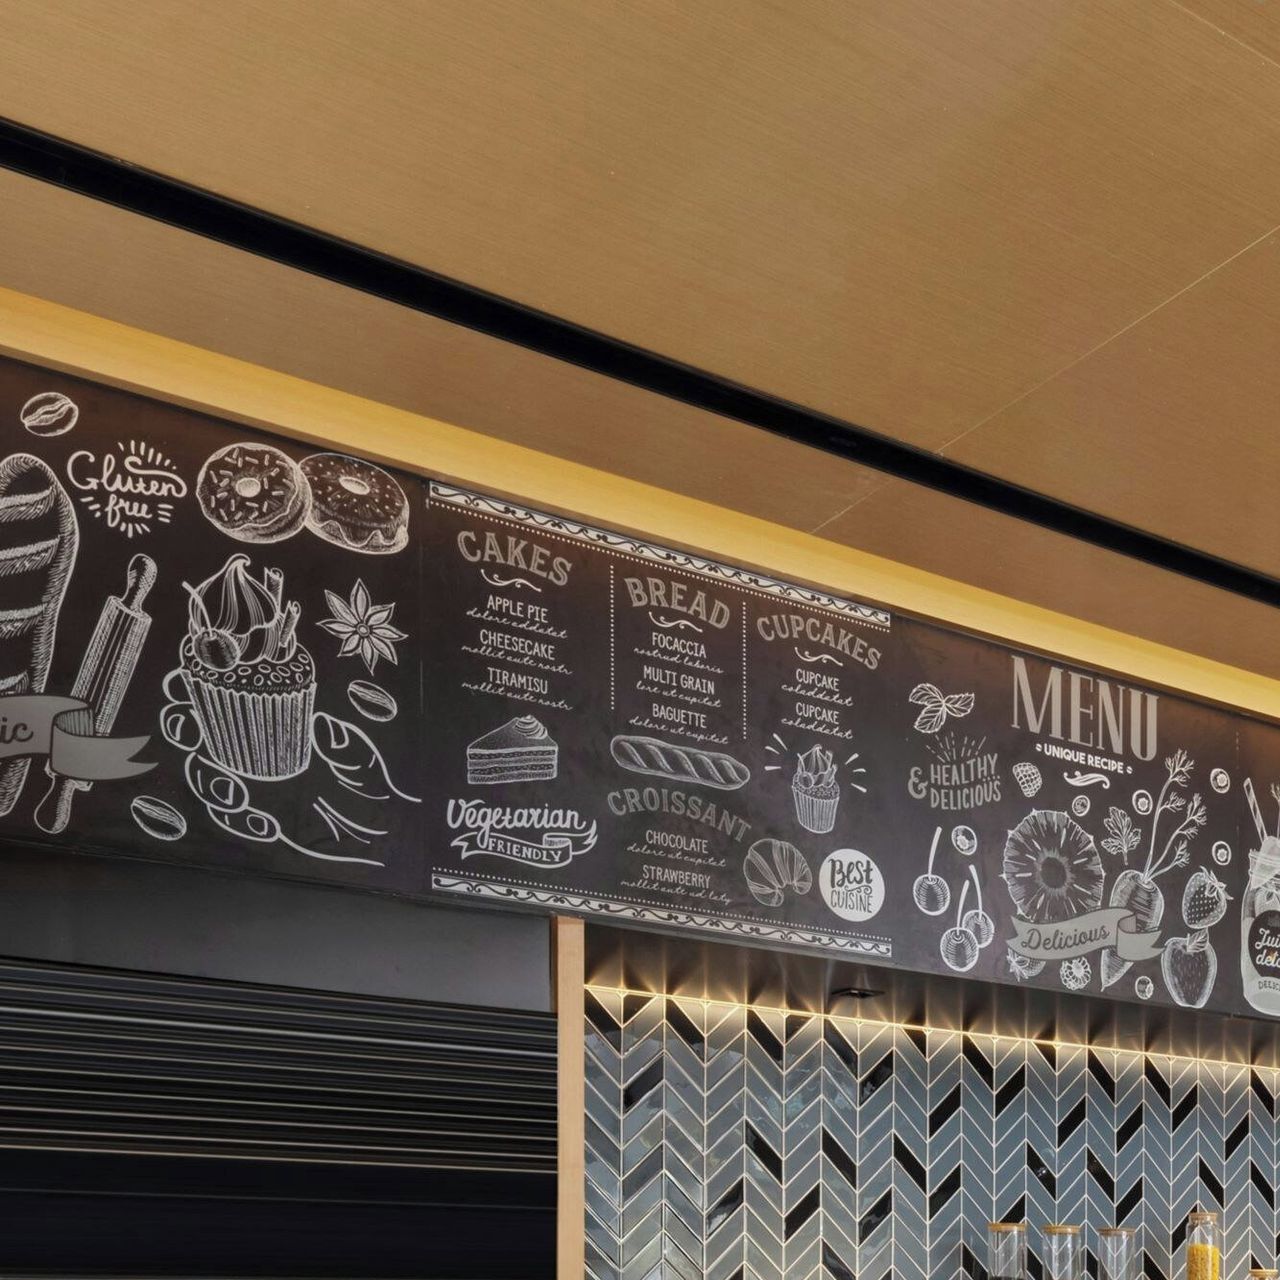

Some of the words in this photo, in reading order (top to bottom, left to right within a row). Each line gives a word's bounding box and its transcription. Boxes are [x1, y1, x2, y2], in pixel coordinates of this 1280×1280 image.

[67, 450, 187, 497] Gluten
[105, 494, 152, 527] free
[457, 530, 572, 586] CAKES
[487, 594, 524, 617] APPLE
[527, 604, 548, 623] PIE
[624, 577, 730, 629] BREAD
[480, 629, 555, 660] CHEESECAKE
[652, 632, 707, 659] FOCACCIA
[757, 614, 882, 670] CUPCAKES
[487, 667, 548, 694] TIRAMISU
[643, 665, 677, 686] MULTI
[680, 674, 715, 695] GRAIN
[795, 668, 840, 691] CUPCAKE
[652, 703, 707, 729] BAGUETTE
[795, 702, 840, 725] CUPCAKE
[1011, 655, 1159, 761] MENU
[1044, 743, 1086, 764] UNIQUE
[1087, 754, 1124, 774] RECIPE
[908, 767, 928, 799] &
[930, 753, 998, 786] HEALTHY
[930, 778, 1001, 810] DELICIOUS
[447, 799, 586, 849] Vegetarian
[607, 787, 752, 842] CROISSANT
[488, 838, 562, 862] FRIENDLY
[646, 830, 708, 854] CHOCOLATE
[642, 864, 711, 889] STRAWBERRY
[830, 890, 872, 913] CUISINE
[1021, 925, 1110, 950] Delicious
